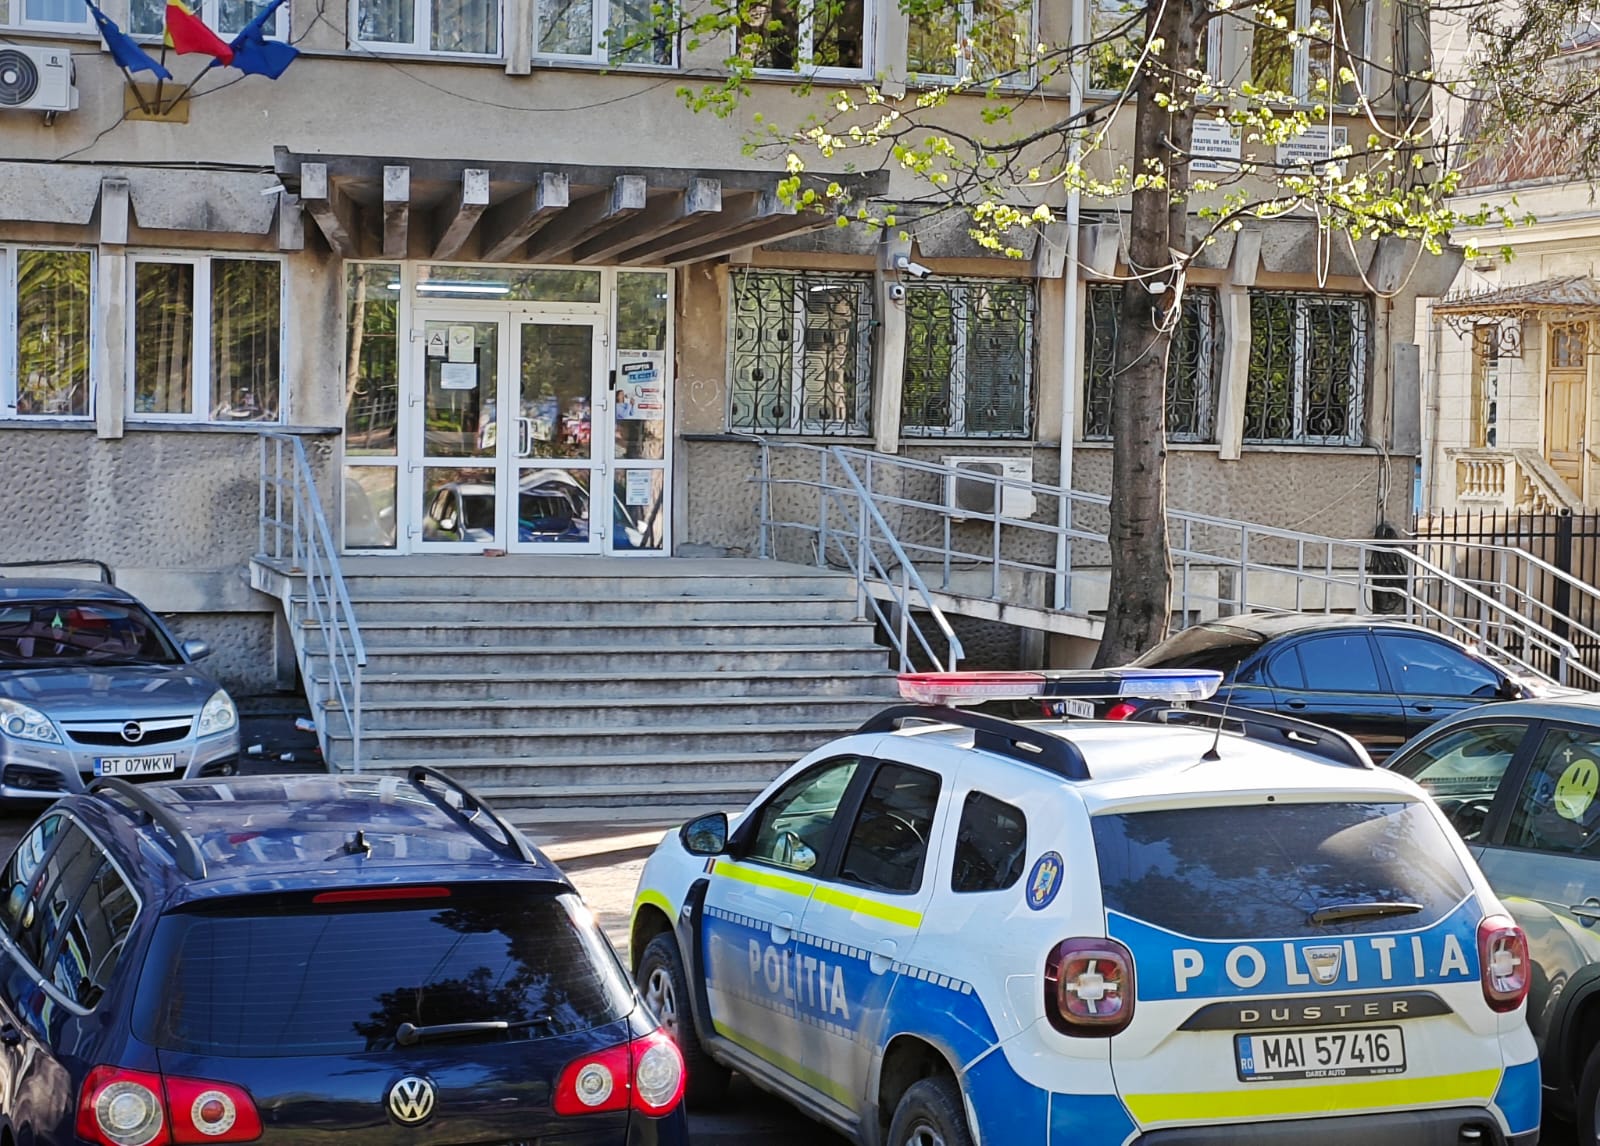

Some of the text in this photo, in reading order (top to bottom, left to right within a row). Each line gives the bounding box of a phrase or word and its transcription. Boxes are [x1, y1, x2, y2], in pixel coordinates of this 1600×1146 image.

[102, 760, 120, 774] BT
[749, 939, 850, 1020] POLITIA
[1172, 934, 1470, 992] POLITIA
[1240, 1001, 1409, 1022] DUSTER
[1241, 1034, 1390, 1070] RO MAI 57416
